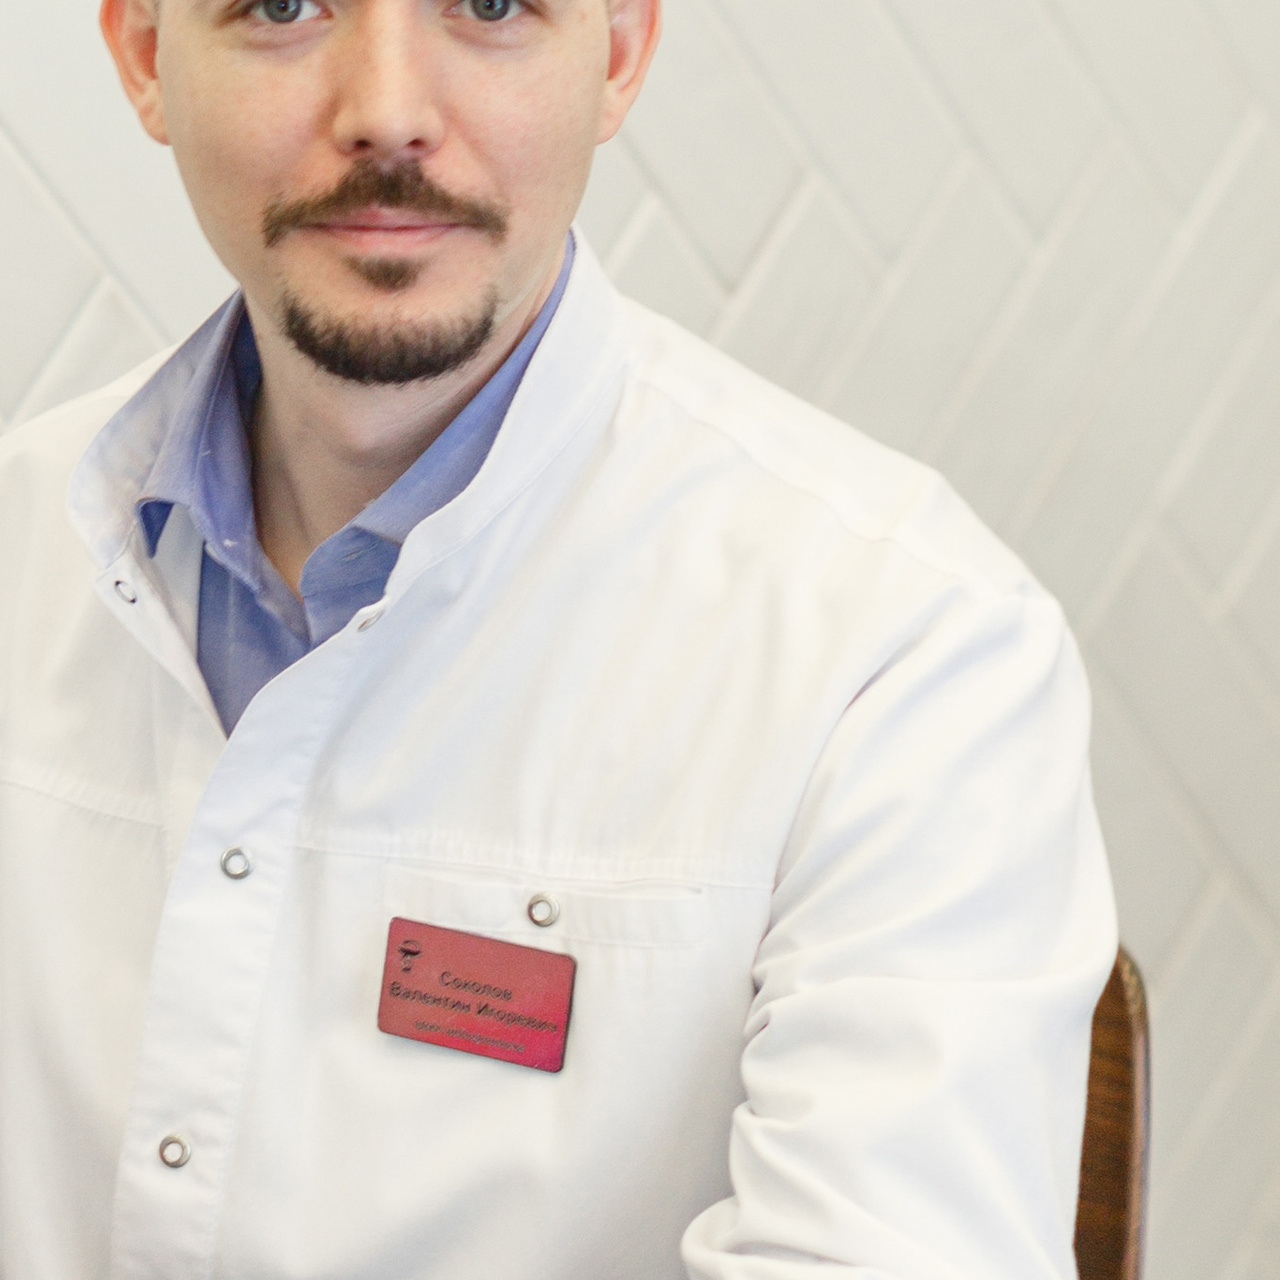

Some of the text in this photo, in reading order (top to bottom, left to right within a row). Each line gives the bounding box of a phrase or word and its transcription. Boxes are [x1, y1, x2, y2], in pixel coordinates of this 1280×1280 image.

[439, 971, 513, 1001] Соколов
[389, 981, 558, 1034] Валентин Игоревич
